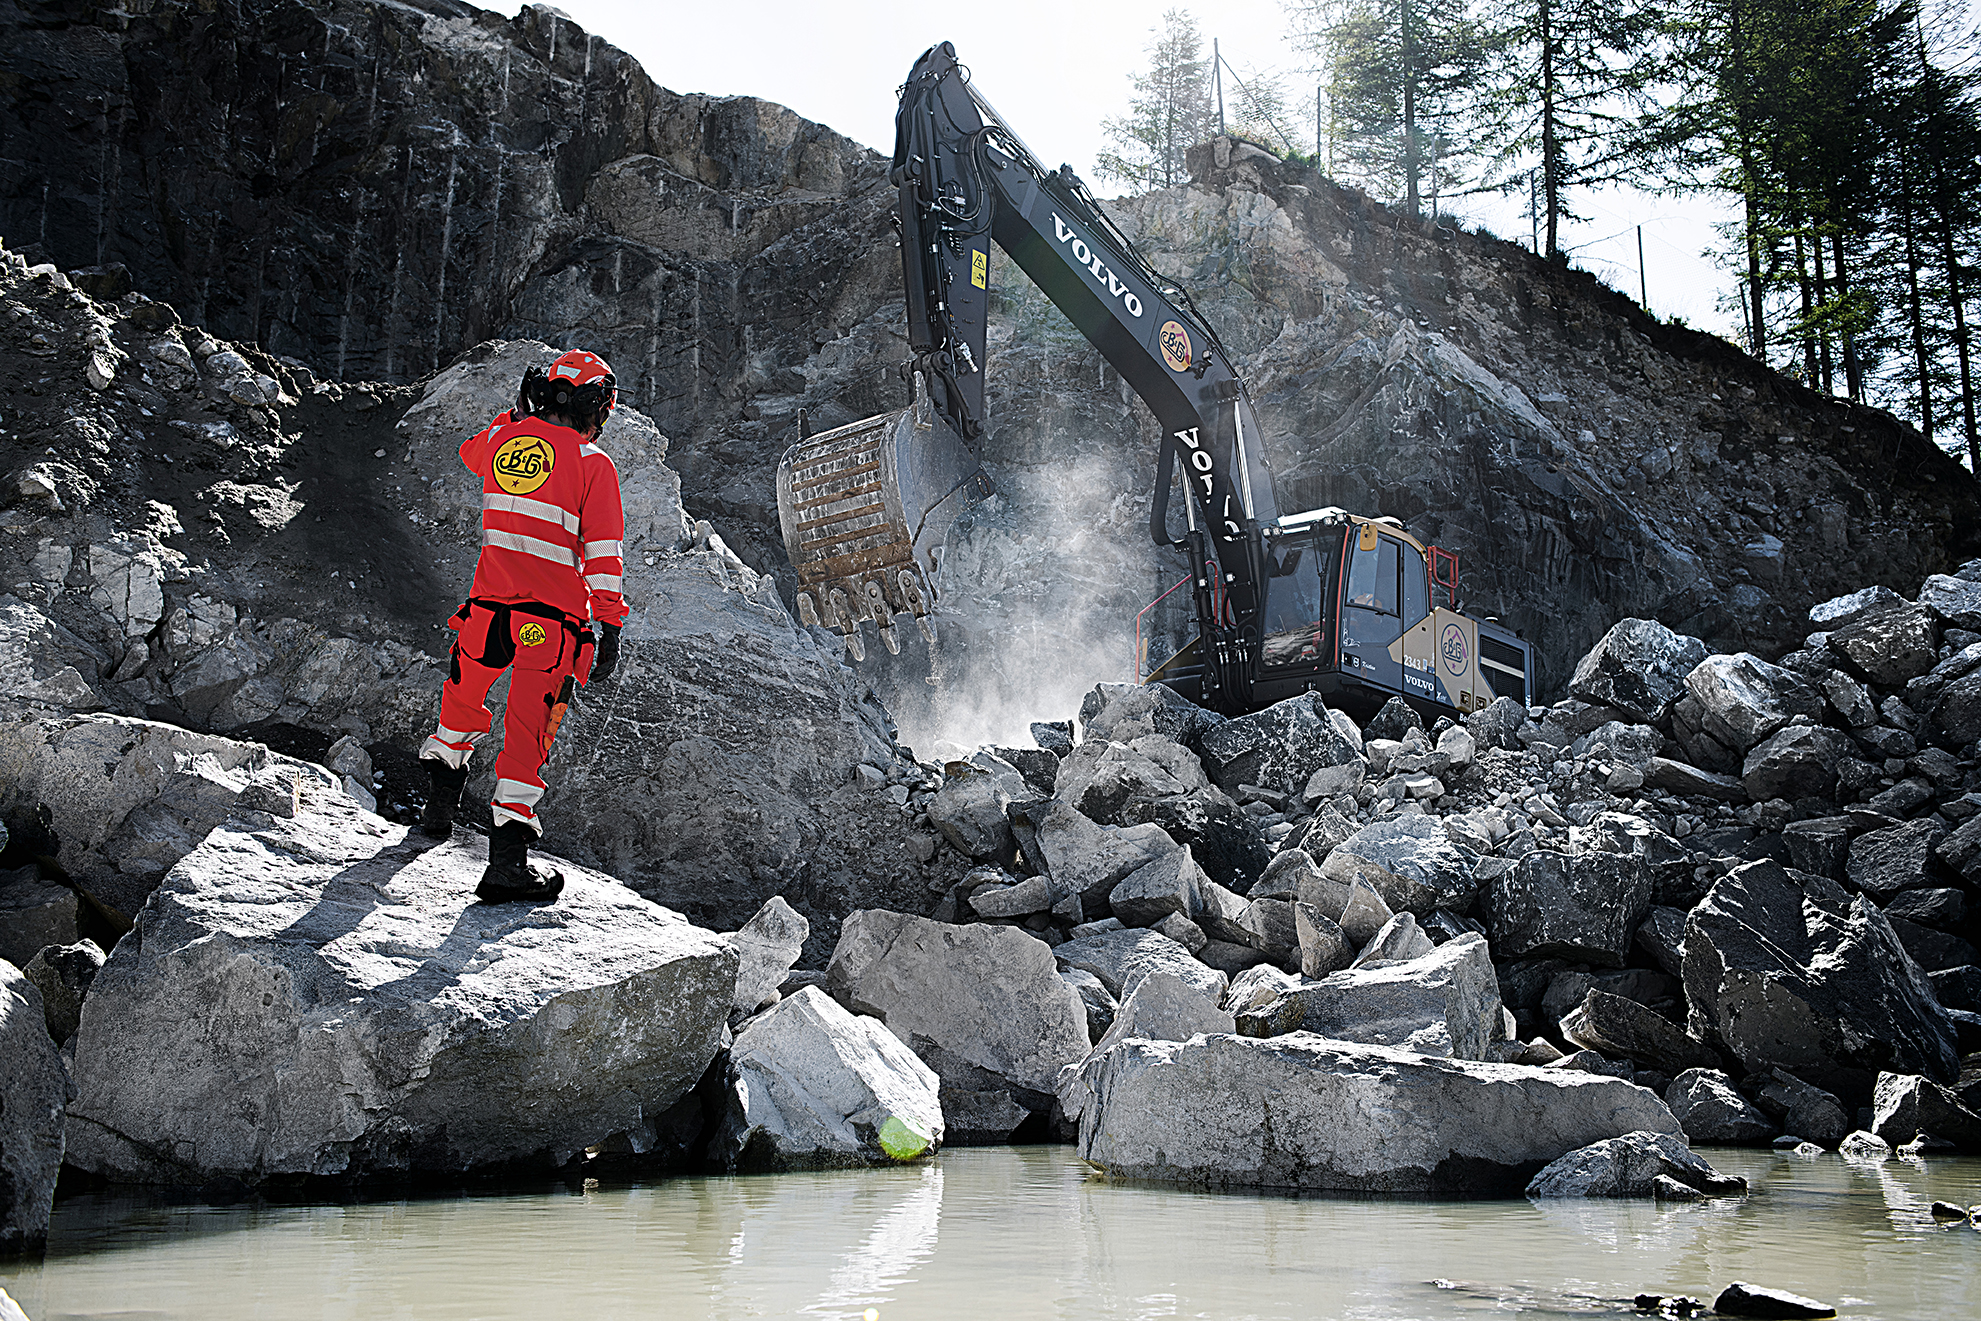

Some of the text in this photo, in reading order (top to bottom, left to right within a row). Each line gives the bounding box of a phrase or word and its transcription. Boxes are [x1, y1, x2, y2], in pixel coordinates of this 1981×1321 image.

[1051, 212, 1143, 318] VOLVO
[496, 449, 542, 479] B&G
[1404, 654, 1421, 670] 2343
[1403, 673, 1435, 692] VOLVO
